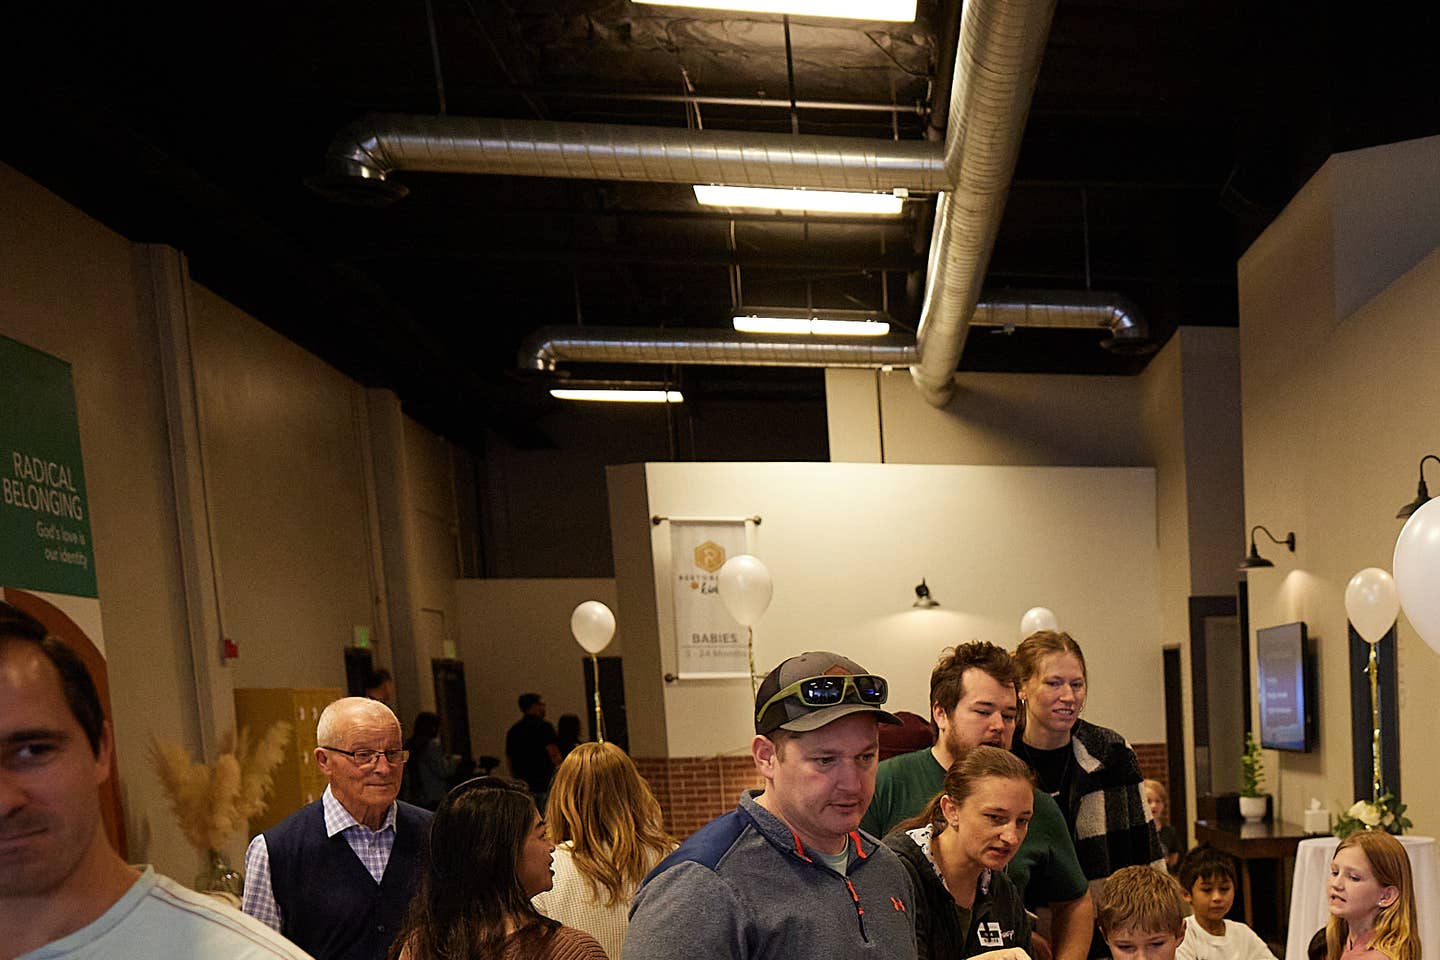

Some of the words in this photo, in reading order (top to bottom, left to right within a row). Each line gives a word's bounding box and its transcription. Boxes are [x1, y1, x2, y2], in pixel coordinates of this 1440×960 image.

[13, 452, 77, 492] RADICAL
[3, 478, 84, 521] BELONGING
[692, 632, 738, 644] BABIES
